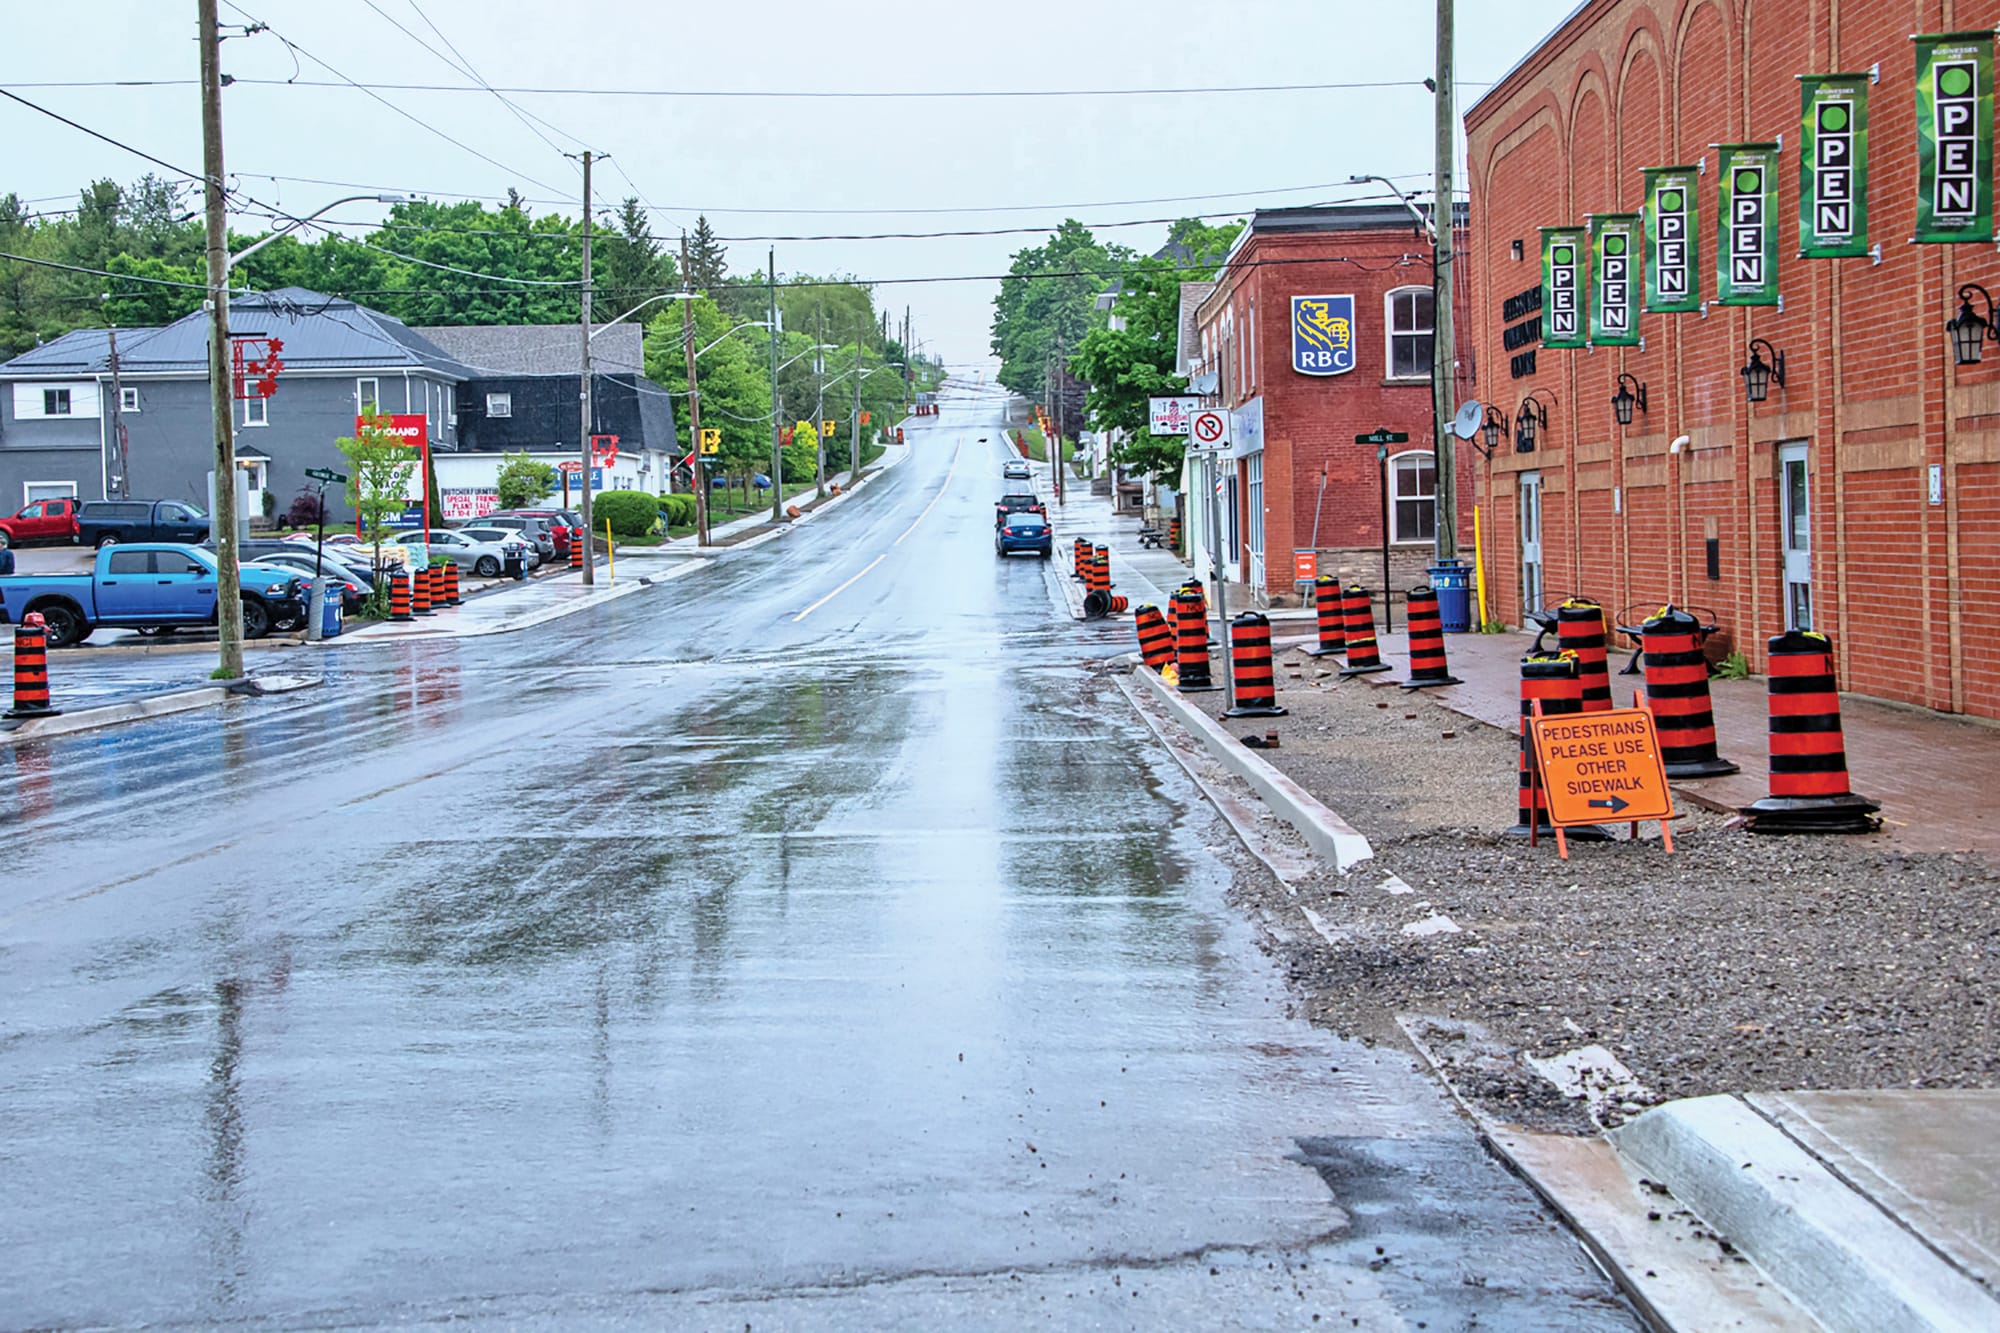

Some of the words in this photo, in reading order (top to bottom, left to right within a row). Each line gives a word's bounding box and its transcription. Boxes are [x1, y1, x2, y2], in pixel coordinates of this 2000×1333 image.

[1932, 47, 1978, 55] BUSINESSES
[1939, 68, 1970, 209] OPEN
[1820, 106, 1847, 231] OPEN
[1736, 171, 1759, 280] OPEN
[1660, 191, 1682, 290] OPEN
[1554, 248, 1572, 332] OPEN
[1605, 237, 1625, 326] OPEN
[1301, 351, 1347, 367] RBC
[475, 502, 490, 510] SALE
[1542, 720, 1645, 740] PEDESTRIANS
[1551, 743, 1608, 759] PLEASE
[1614, 739, 1645, 754] USE
[1576, 759, 1627, 775] OTHER
[1567, 777, 1644, 795] SIDEWALK
